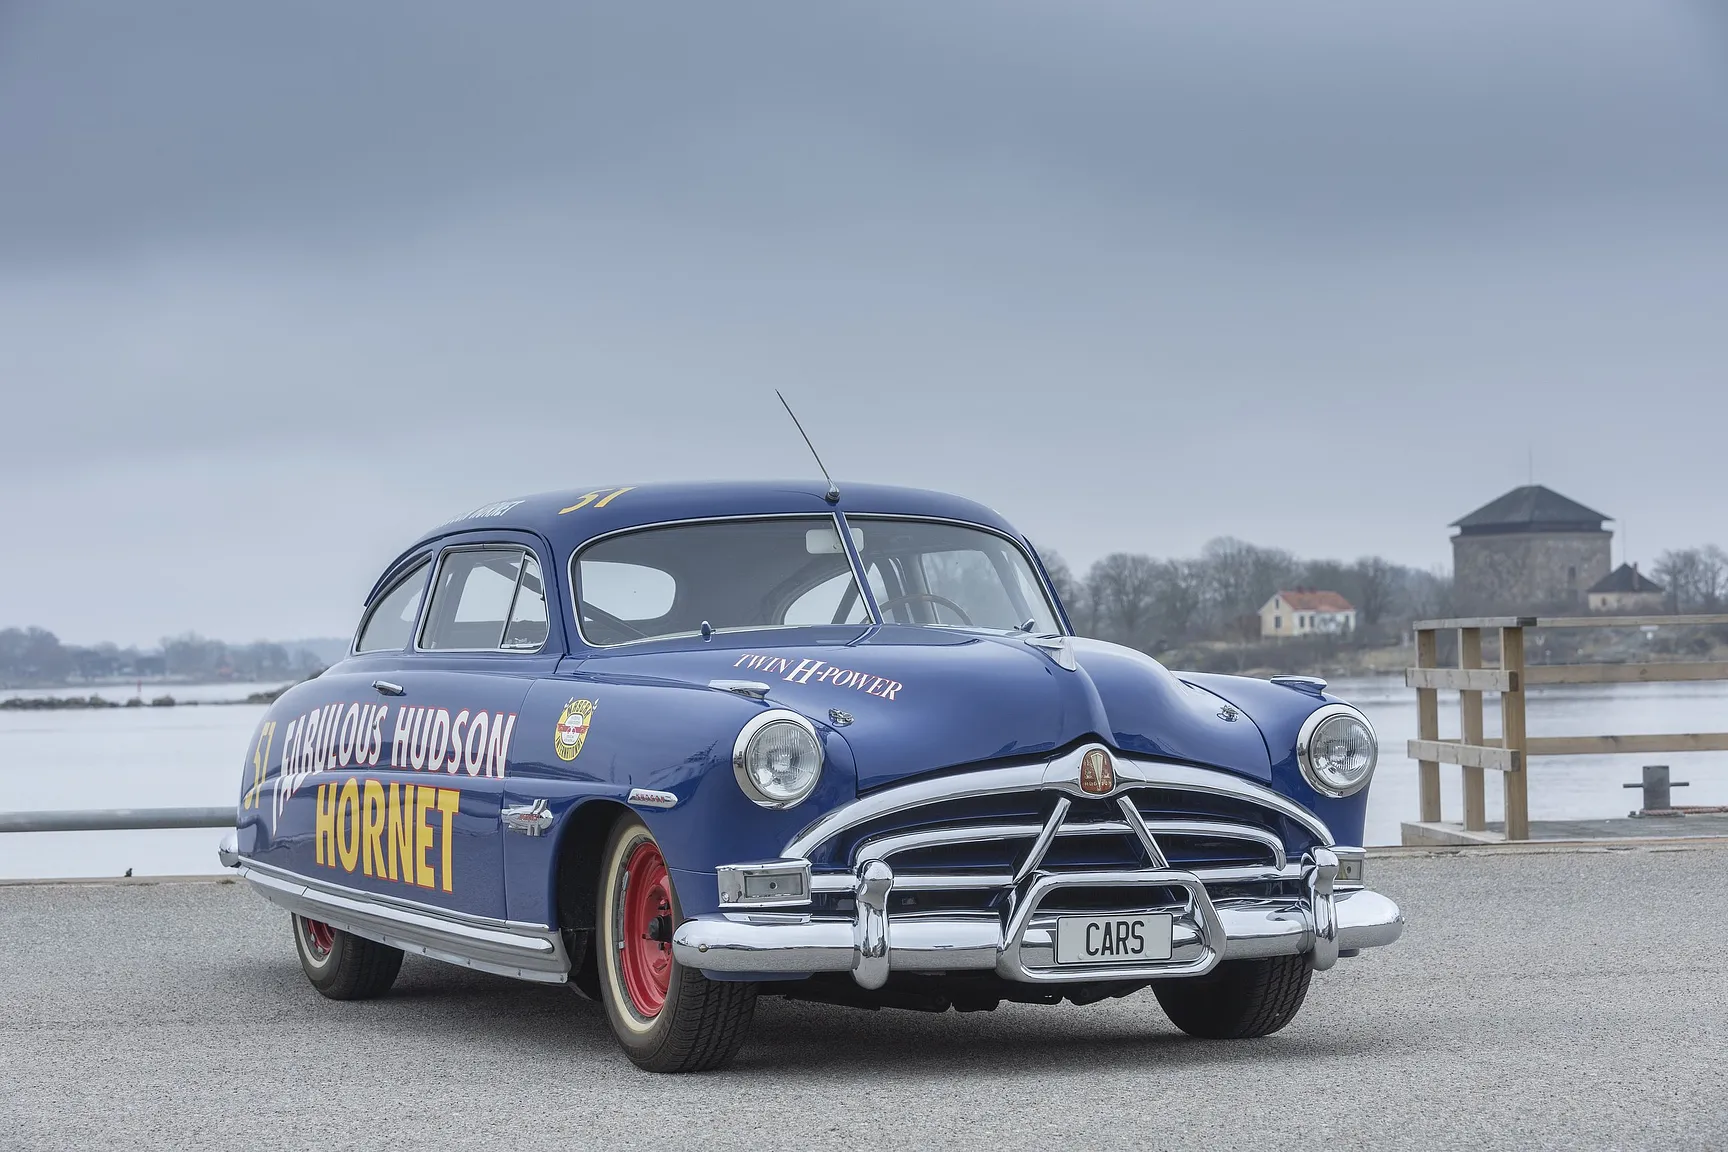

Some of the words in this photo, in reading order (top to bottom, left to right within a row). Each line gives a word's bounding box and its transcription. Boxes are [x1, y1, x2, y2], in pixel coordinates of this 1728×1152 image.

[557, 487, 638, 515] 51
[733, 653, 794, 674] TWIN
[782, 658, 904, 701] H-POWER
[244, 721, 277, 810] 51
[272, 702, 389, 837] FABULOUS
[390, 705, 517, 779] HUDSON
[316, 776, 461, 893] HORNET
[1085, 920, 1145, 956] CARS
